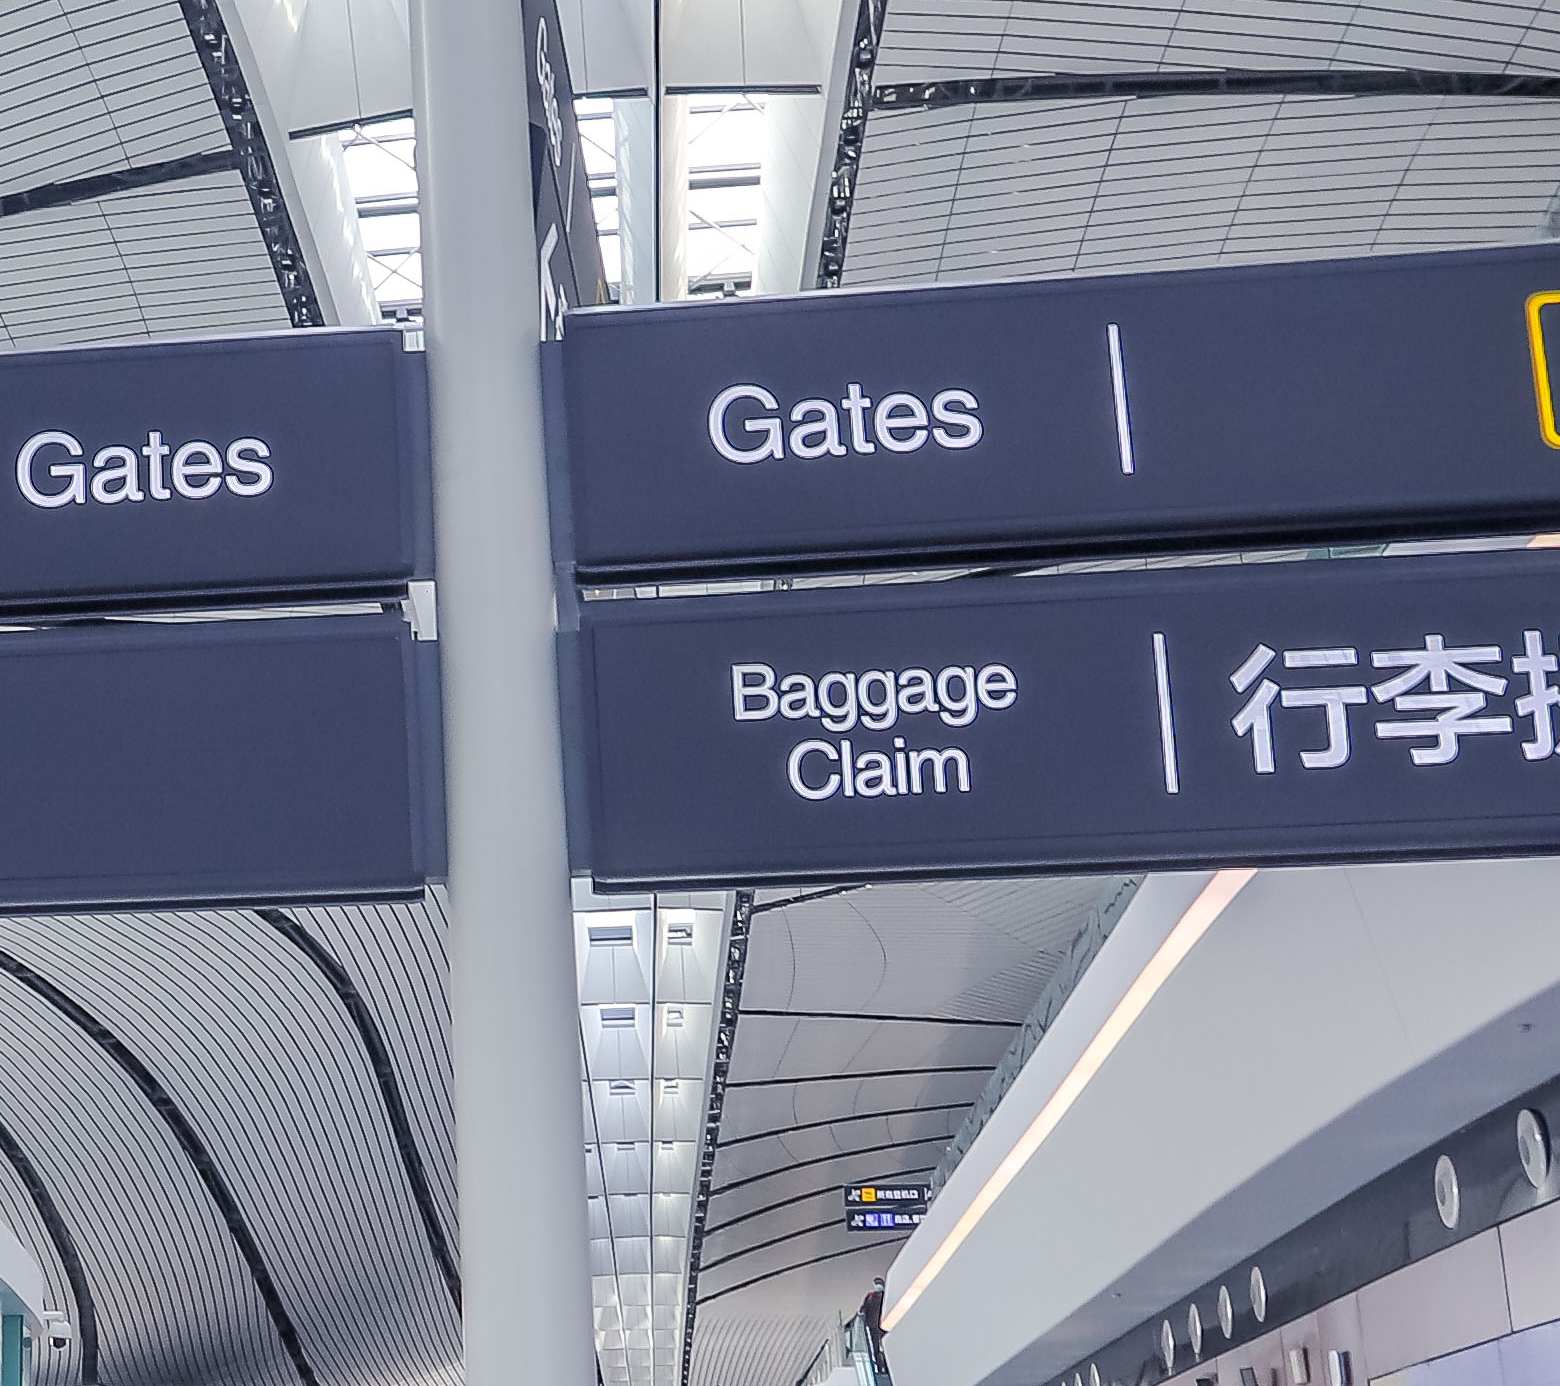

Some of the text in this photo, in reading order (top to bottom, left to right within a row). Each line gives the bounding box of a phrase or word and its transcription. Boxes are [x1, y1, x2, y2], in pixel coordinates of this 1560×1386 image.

[708, 382, 985, 465] Gates
[15, 430, 274, 508] Gates
[730, 661, 1018, 734] Baggage
[786, 737, 972, 802] Claim
